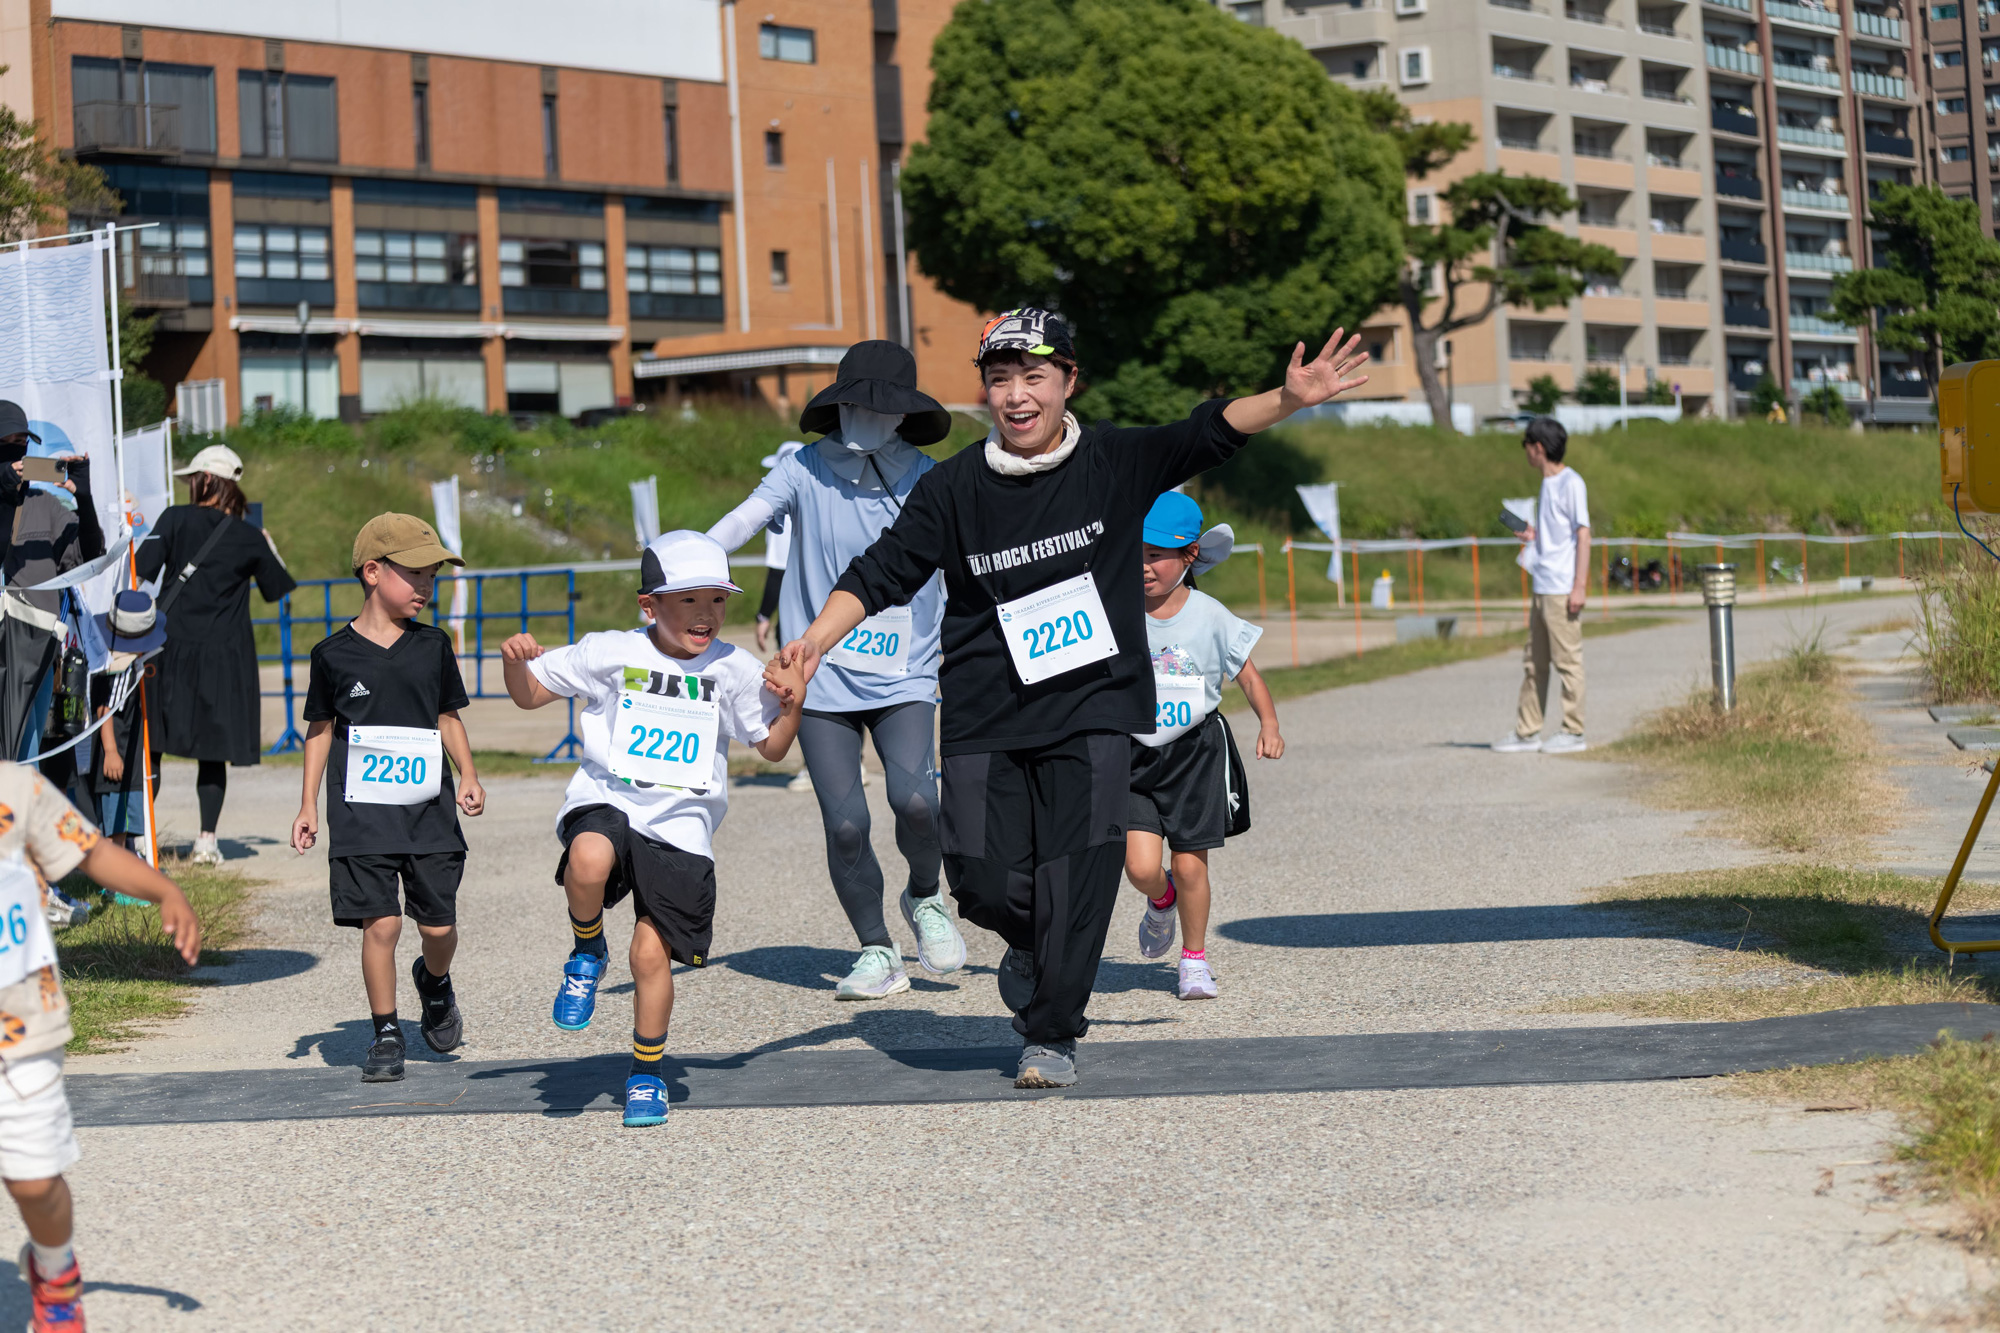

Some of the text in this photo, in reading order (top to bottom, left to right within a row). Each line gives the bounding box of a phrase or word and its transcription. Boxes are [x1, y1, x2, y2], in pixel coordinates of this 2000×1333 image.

[967, 554, 993, 576] UJI
[994, 545, 1032, 571] ROCK
[1013, 583, 1090, 615] OKAZAKI RIVERSIDE MARATHON
[842, 627, 900, 657] 2230
[1022, 609, 1093, 660] 2220
[349, 690, 371, 698] adidas
[658, 705, 686, 714] RIVERSIDE
[687, 709, 714, 717] MARATHON
[627, 725, 700, 764] 2220
[361, 754, 427, 785] 2230
